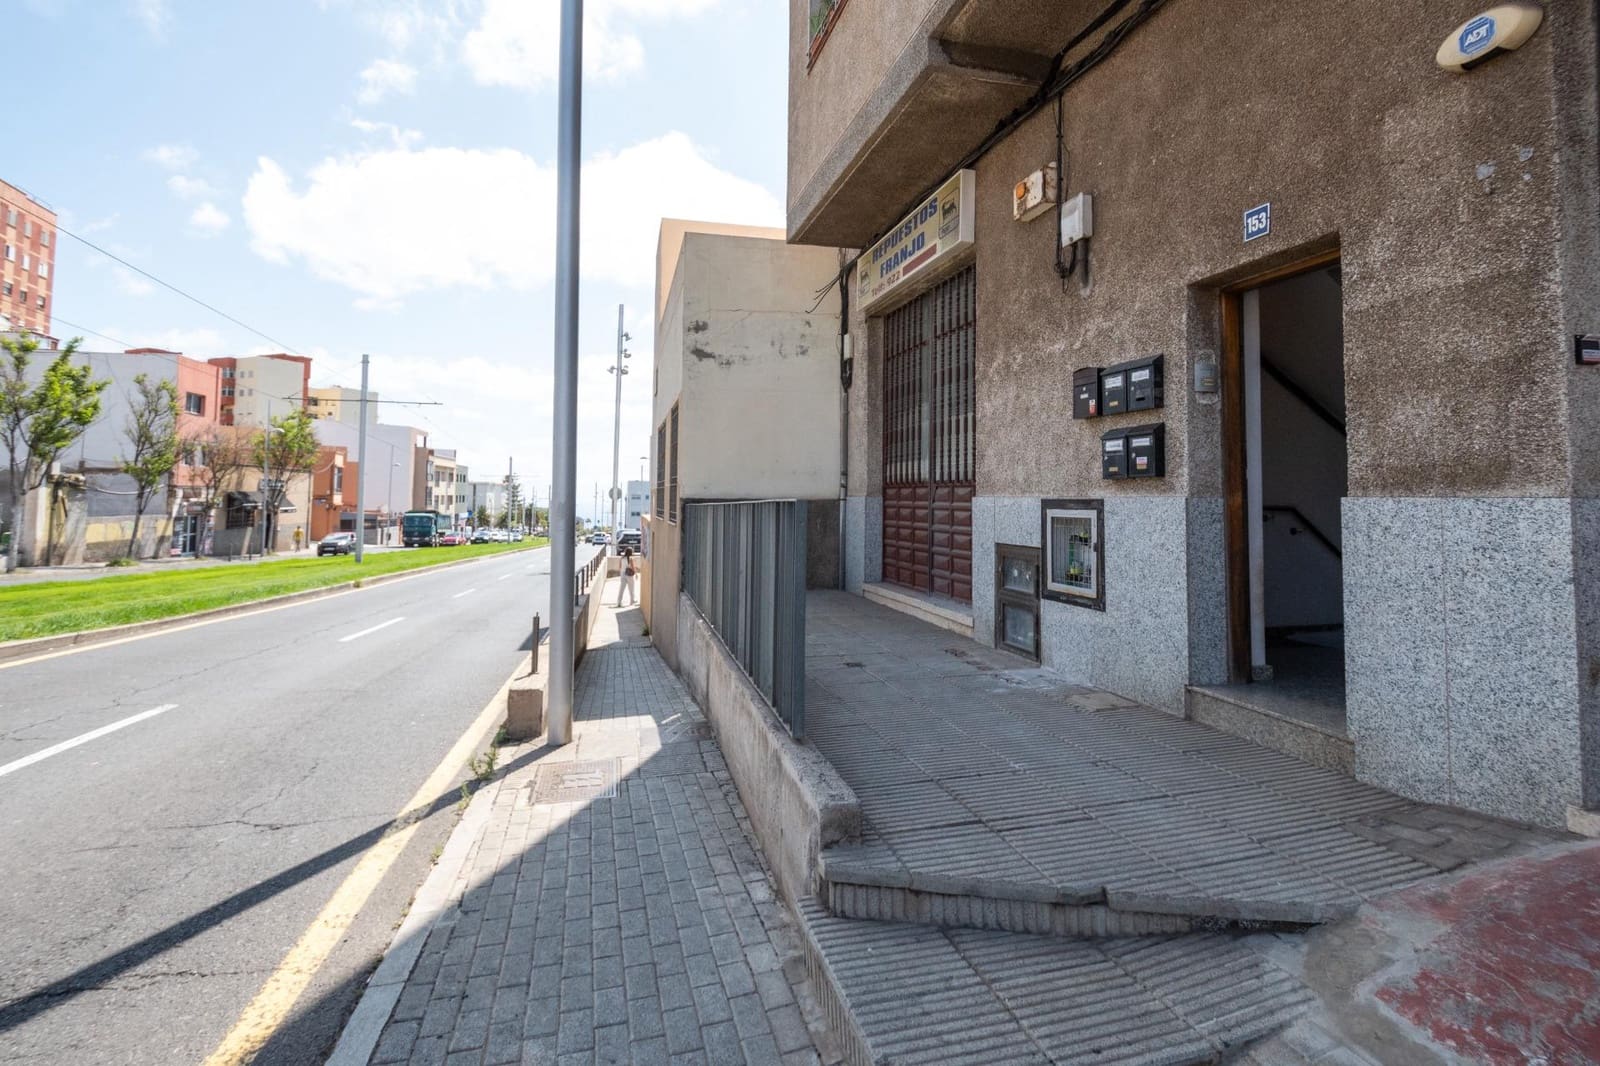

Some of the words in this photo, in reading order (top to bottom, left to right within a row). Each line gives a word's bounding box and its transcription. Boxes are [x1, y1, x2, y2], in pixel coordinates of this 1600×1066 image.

[1463, 23, 1490, 47] ADT
[872, 197, 938, 264] REPUESTOS
[1247, 212, 1267, 234] 153
[880, 231, 925, 278] FRANJO
[886, 270, 901, 286] 922
